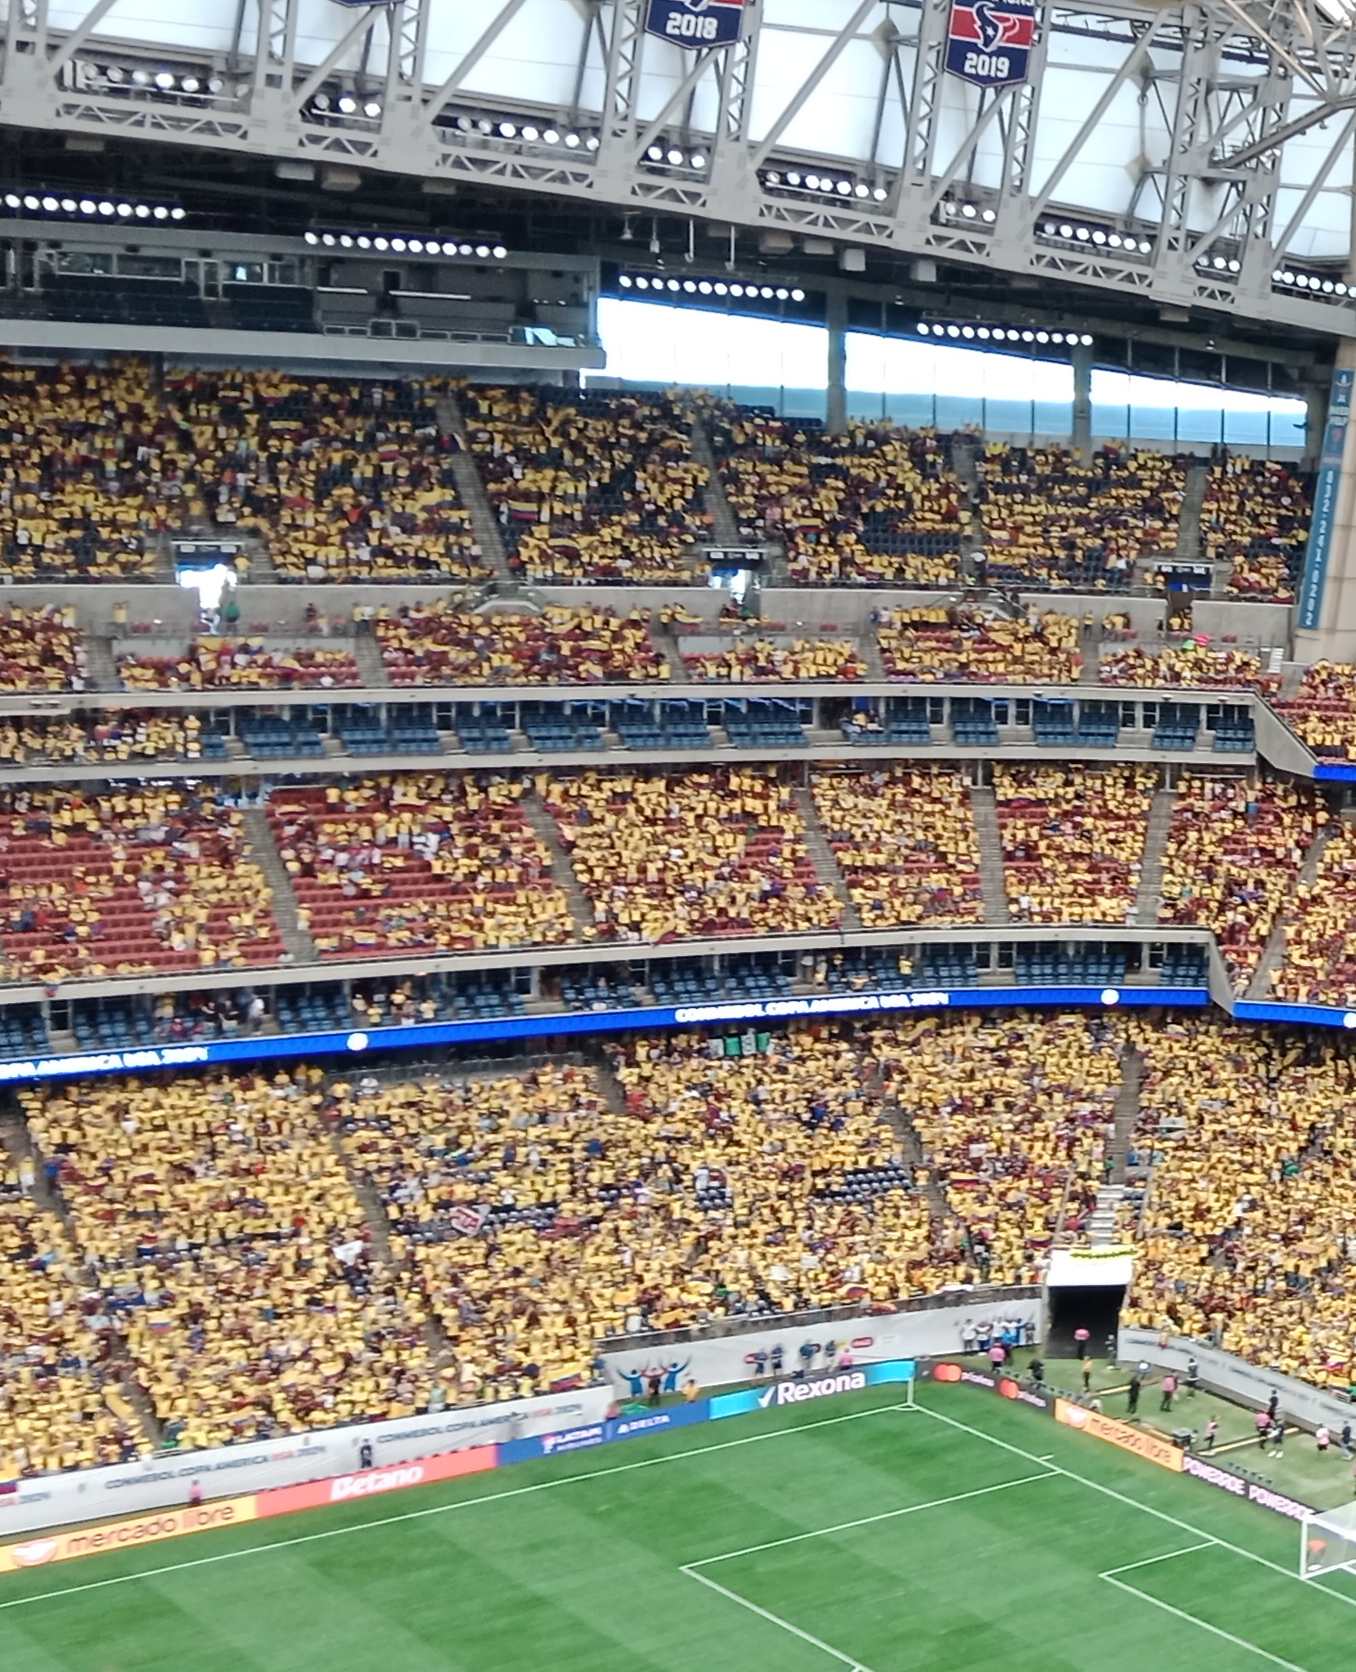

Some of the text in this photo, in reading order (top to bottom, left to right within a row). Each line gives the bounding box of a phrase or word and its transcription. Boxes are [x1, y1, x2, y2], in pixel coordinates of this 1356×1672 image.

[666, 12, 718, 39] 2018
[964, 52, 1010, 78] 2019
[776, 1371, 866, 1405] Rexona
[629, 1414, 671, 1431] DELTA
[330, 1465, 424, 1502] Betano
[66, 1504, 236, 1555] mercado libre
